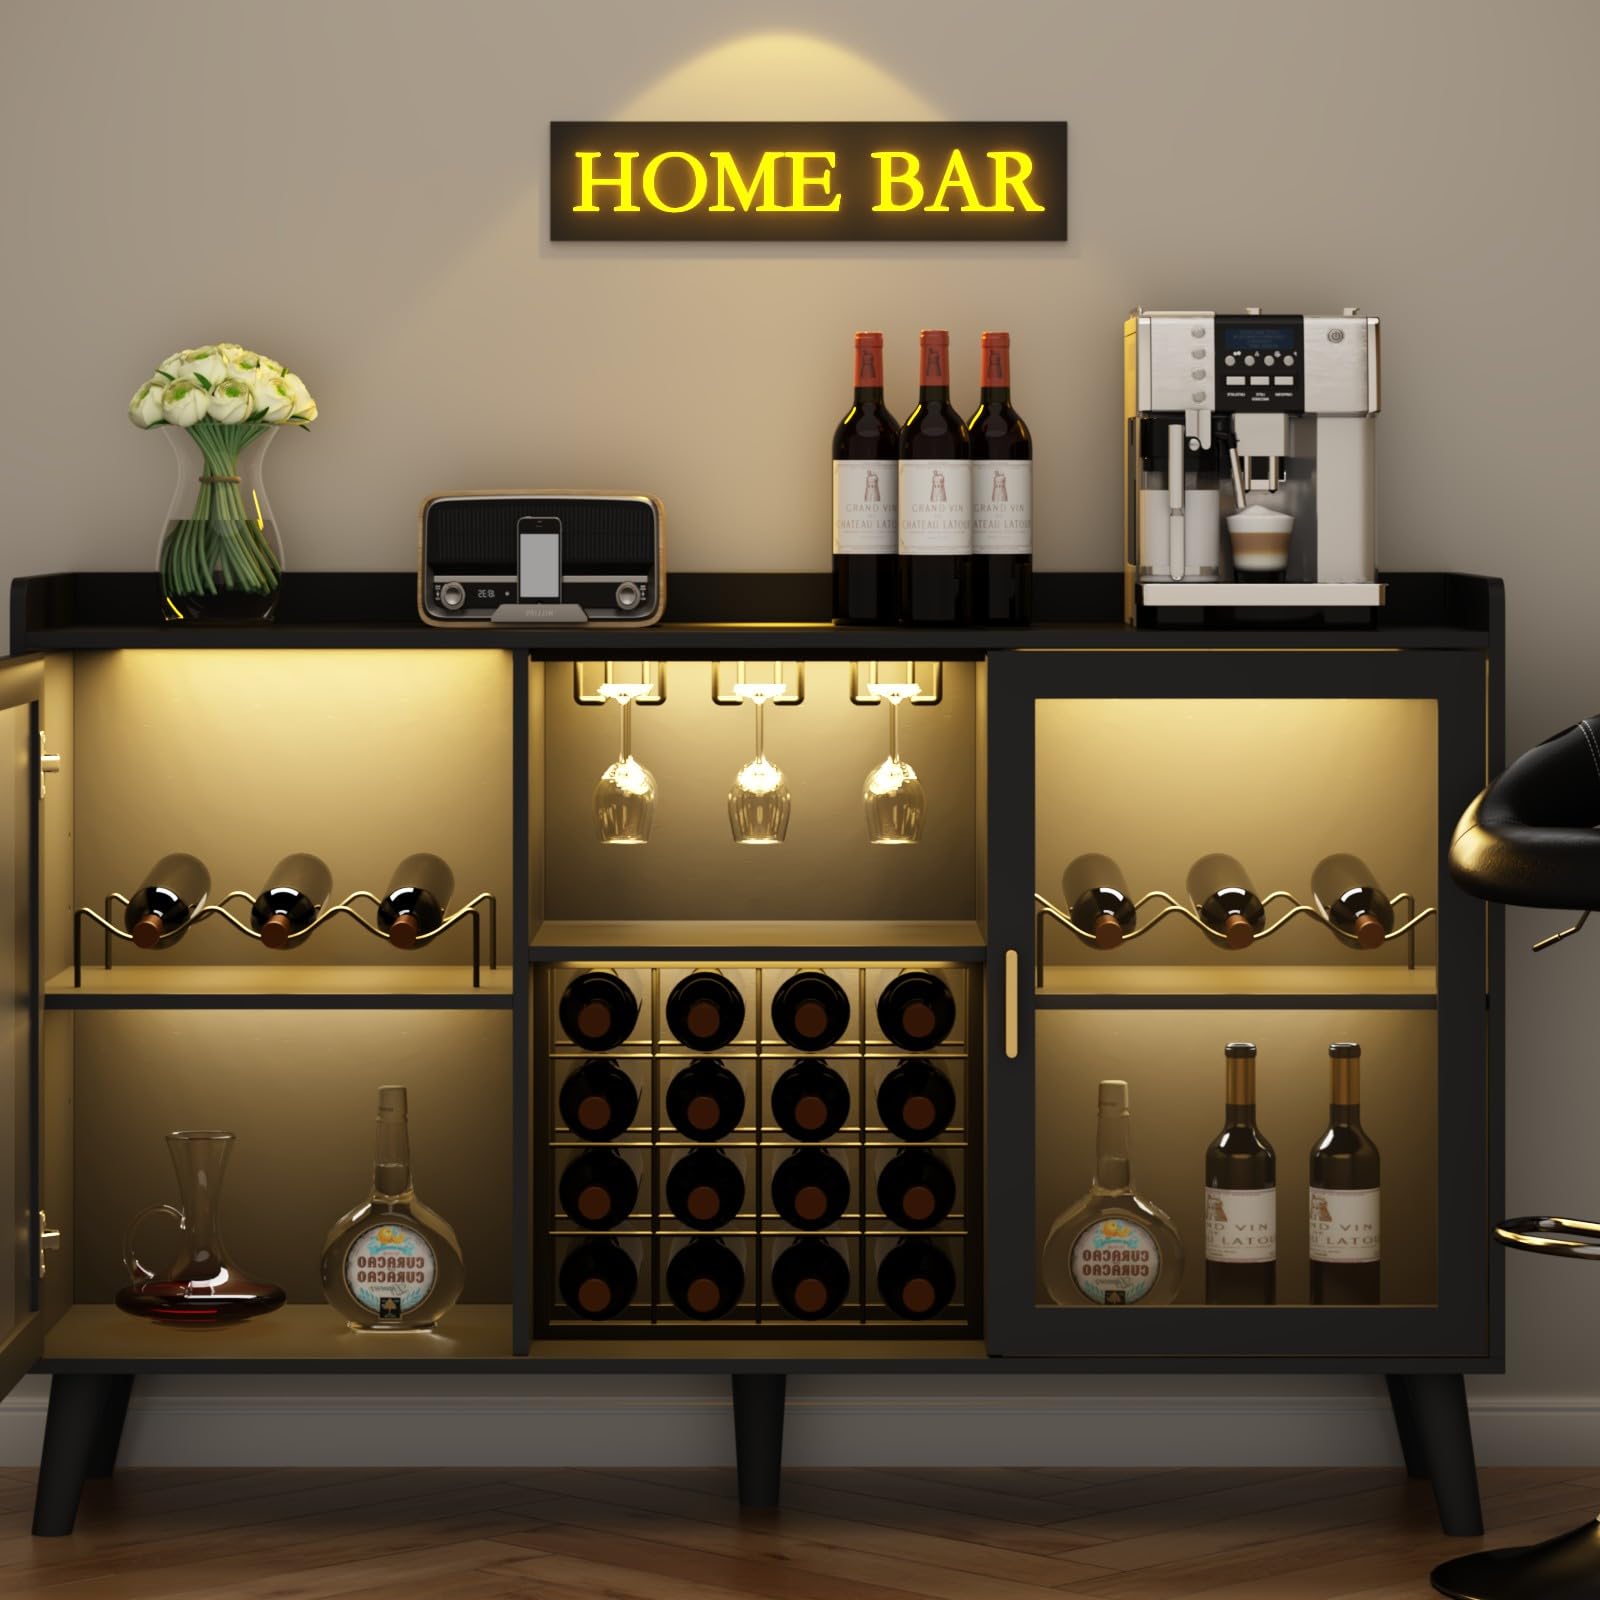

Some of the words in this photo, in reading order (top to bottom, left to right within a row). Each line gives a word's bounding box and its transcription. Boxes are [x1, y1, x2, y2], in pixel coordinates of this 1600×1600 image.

[573, 151, 841, 213] HOME
[871, 149, 1045, 212] BAR
[846, 504, 879, 513] GRAND
[911, 504, 945, 513] GRAND
[949, 504, 963, 513] VIN
[1009, 504, 1024, 513] VIN
[1234, 1224, 1268, 1232] VIN
[1339, 1224, 1373, 1232] VIN
